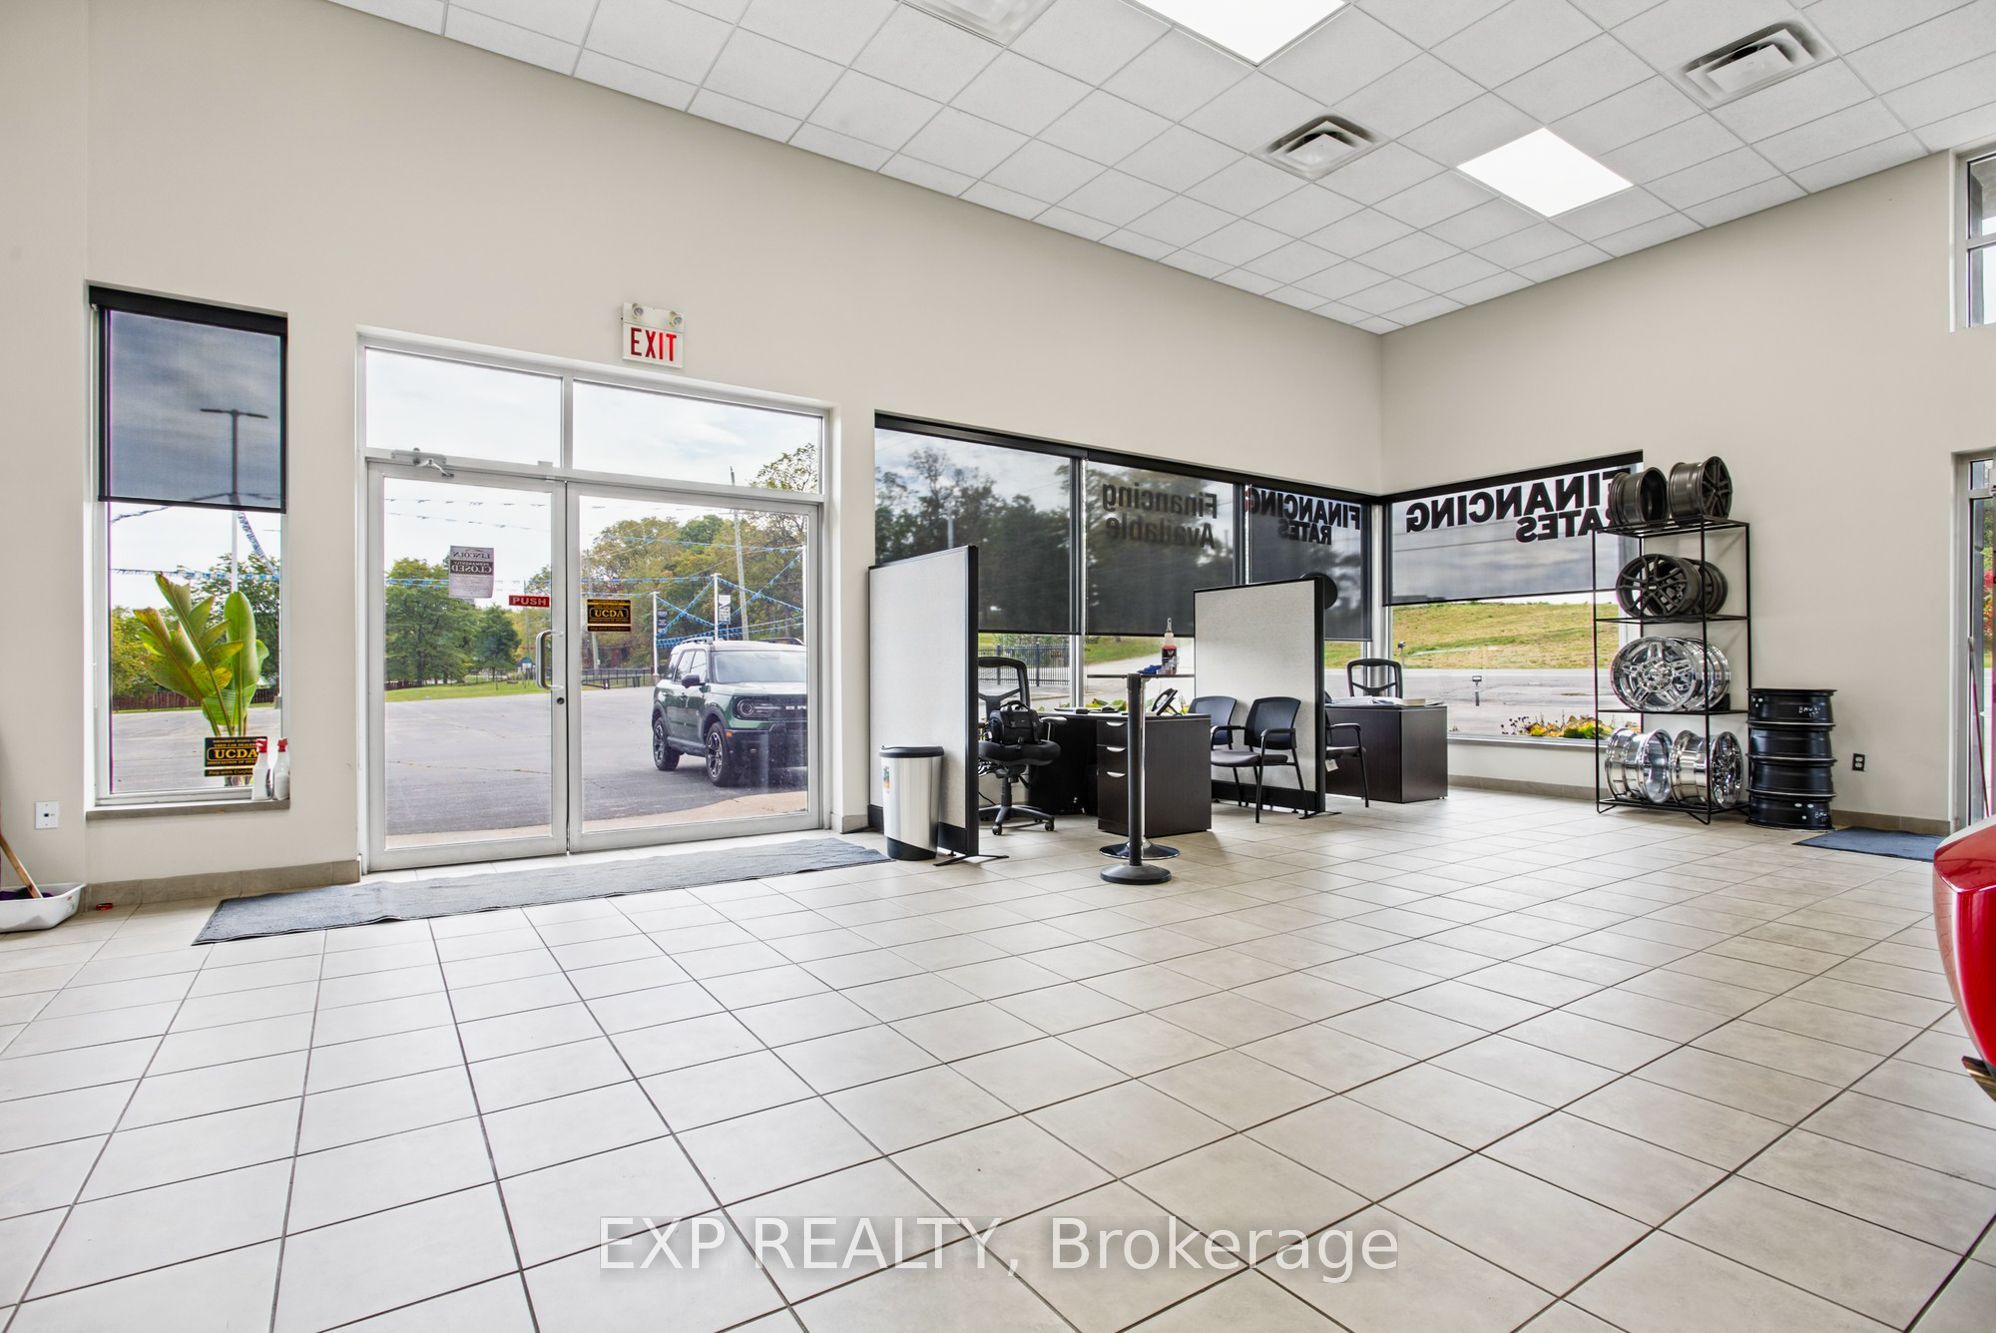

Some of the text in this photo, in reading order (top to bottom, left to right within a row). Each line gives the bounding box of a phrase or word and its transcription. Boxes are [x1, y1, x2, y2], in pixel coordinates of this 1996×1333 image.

[630, 326, 678, 362] EXIT
[512, 596, 547, 606] PUSH
[594, 609, 624, 618] UCDA
[214, 749, 258, 759] UCDA
